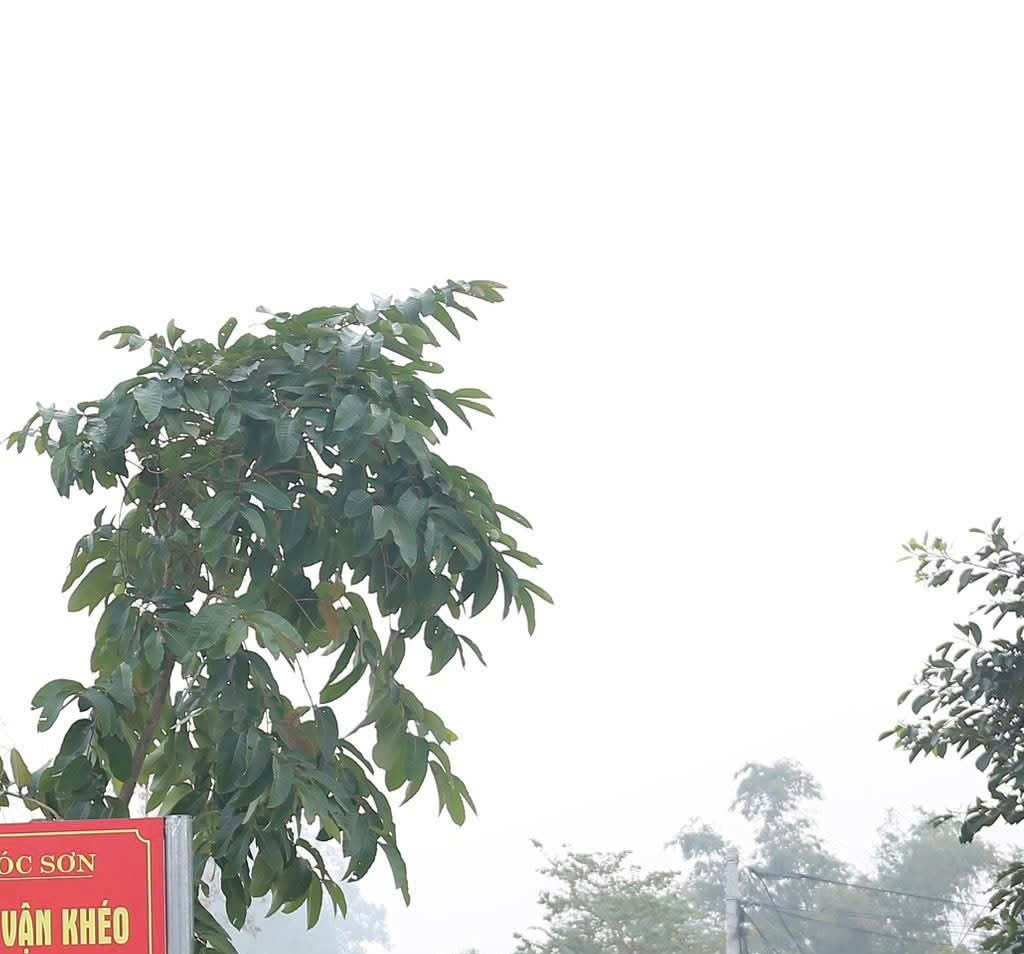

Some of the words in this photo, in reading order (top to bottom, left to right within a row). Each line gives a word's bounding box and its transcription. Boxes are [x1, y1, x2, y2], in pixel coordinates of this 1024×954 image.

[40, 851, 97, 874] SƠN
[1, 901, 52, 954] VẬN
[61, 899, 130, 946] KHÉO
